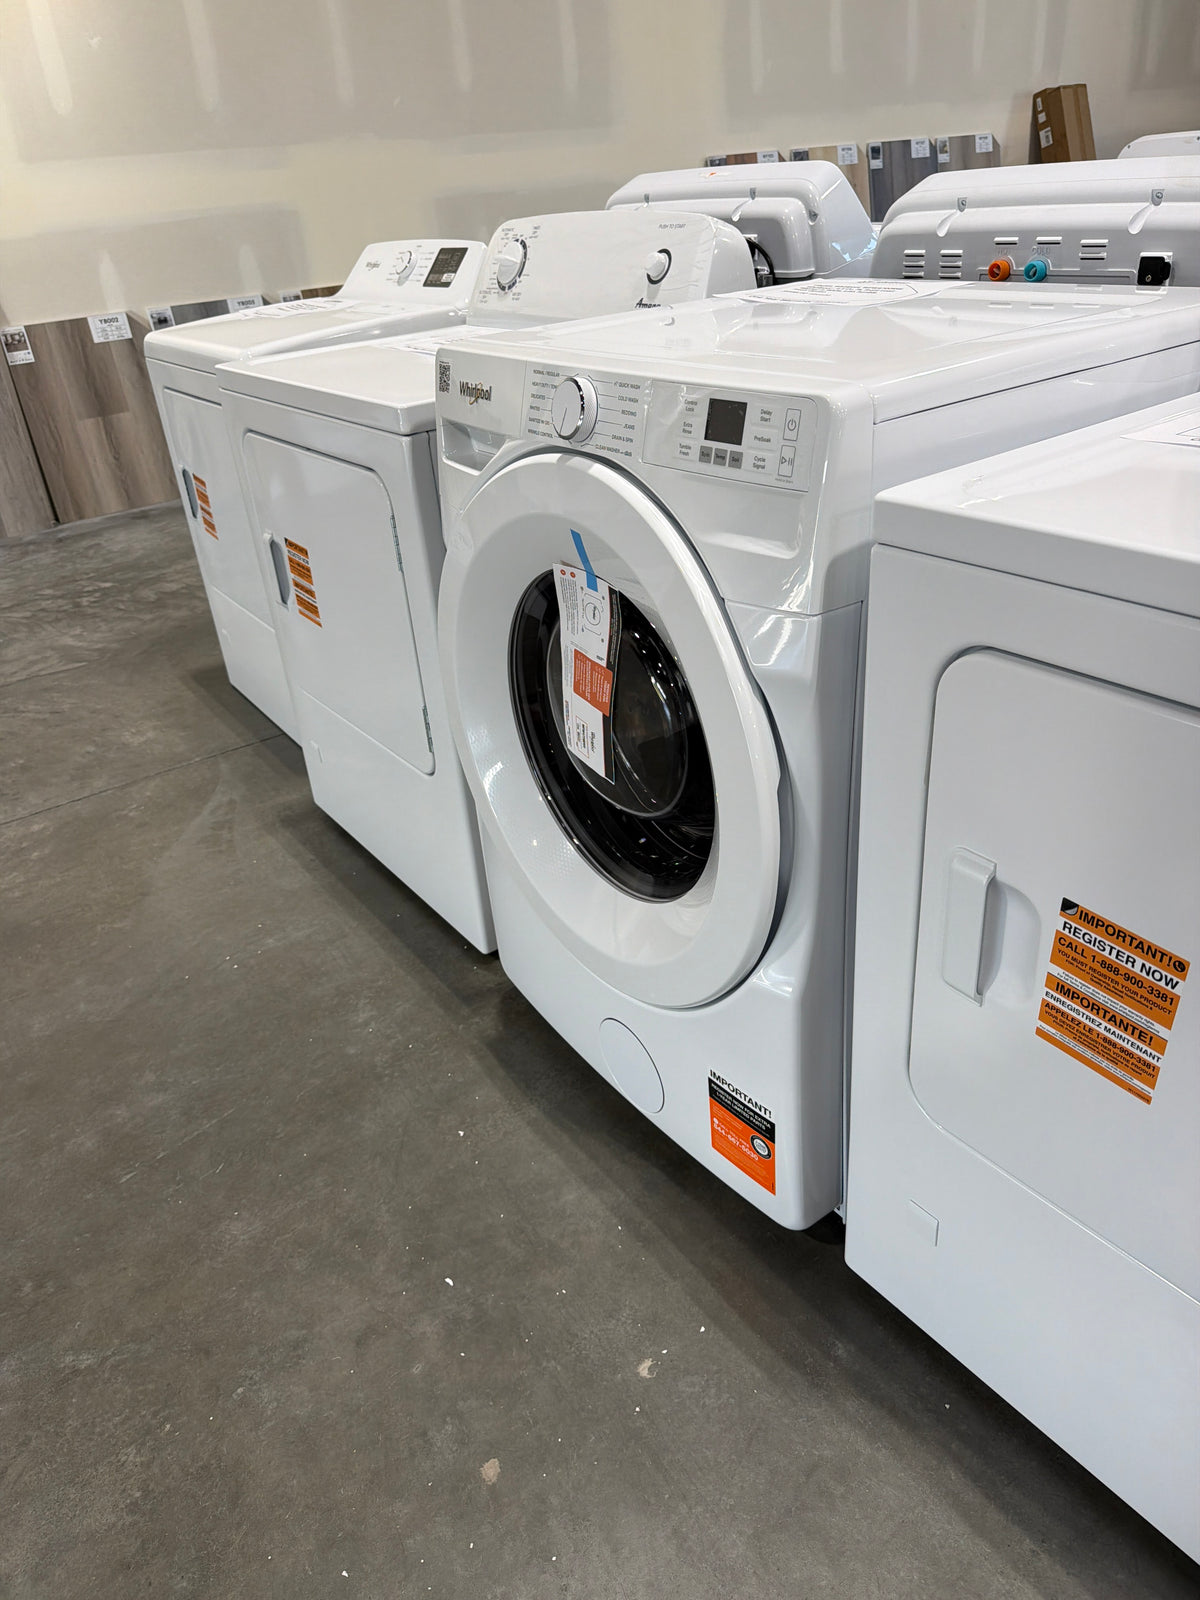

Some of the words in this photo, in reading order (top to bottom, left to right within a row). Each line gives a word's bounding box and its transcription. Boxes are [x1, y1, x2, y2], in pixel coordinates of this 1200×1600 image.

[459, 380, 492, 405] Whirlpool
[760, 408, 773, 417] Delay
[753, 455, 766, 463] Cycle
[1062, 920, 1136, 968] REGISTER
[1139, 961, 1179, 991] NOW
[1078, 909, 1172, 967] IMPORTANT!
[1057, 935, 1088, 959] CALL
[1089, 953, 1174, 1006] 1-888-900-3381
[1088, 965, 1119, 986] REGISTER
[1120, 983, 1138, 997] YOUR
[1139, 994, 1171, 1015] PRODUCT
[1044, 990, 1103, 1029] ENREGISTREZ
[1103, 1024, 1162, 1064] MAINTENANT
[1044, 1001, 1081, 1028] APPELEZ
[1082, 1024, 1093, 1035] LE
[1095, 1032, 1155, 1072] 1-888-900-3381
[1054, 981, 1153, 1046] IMPORTANTE!
[709, 1069, 772, 1119] IMPORTANT!
